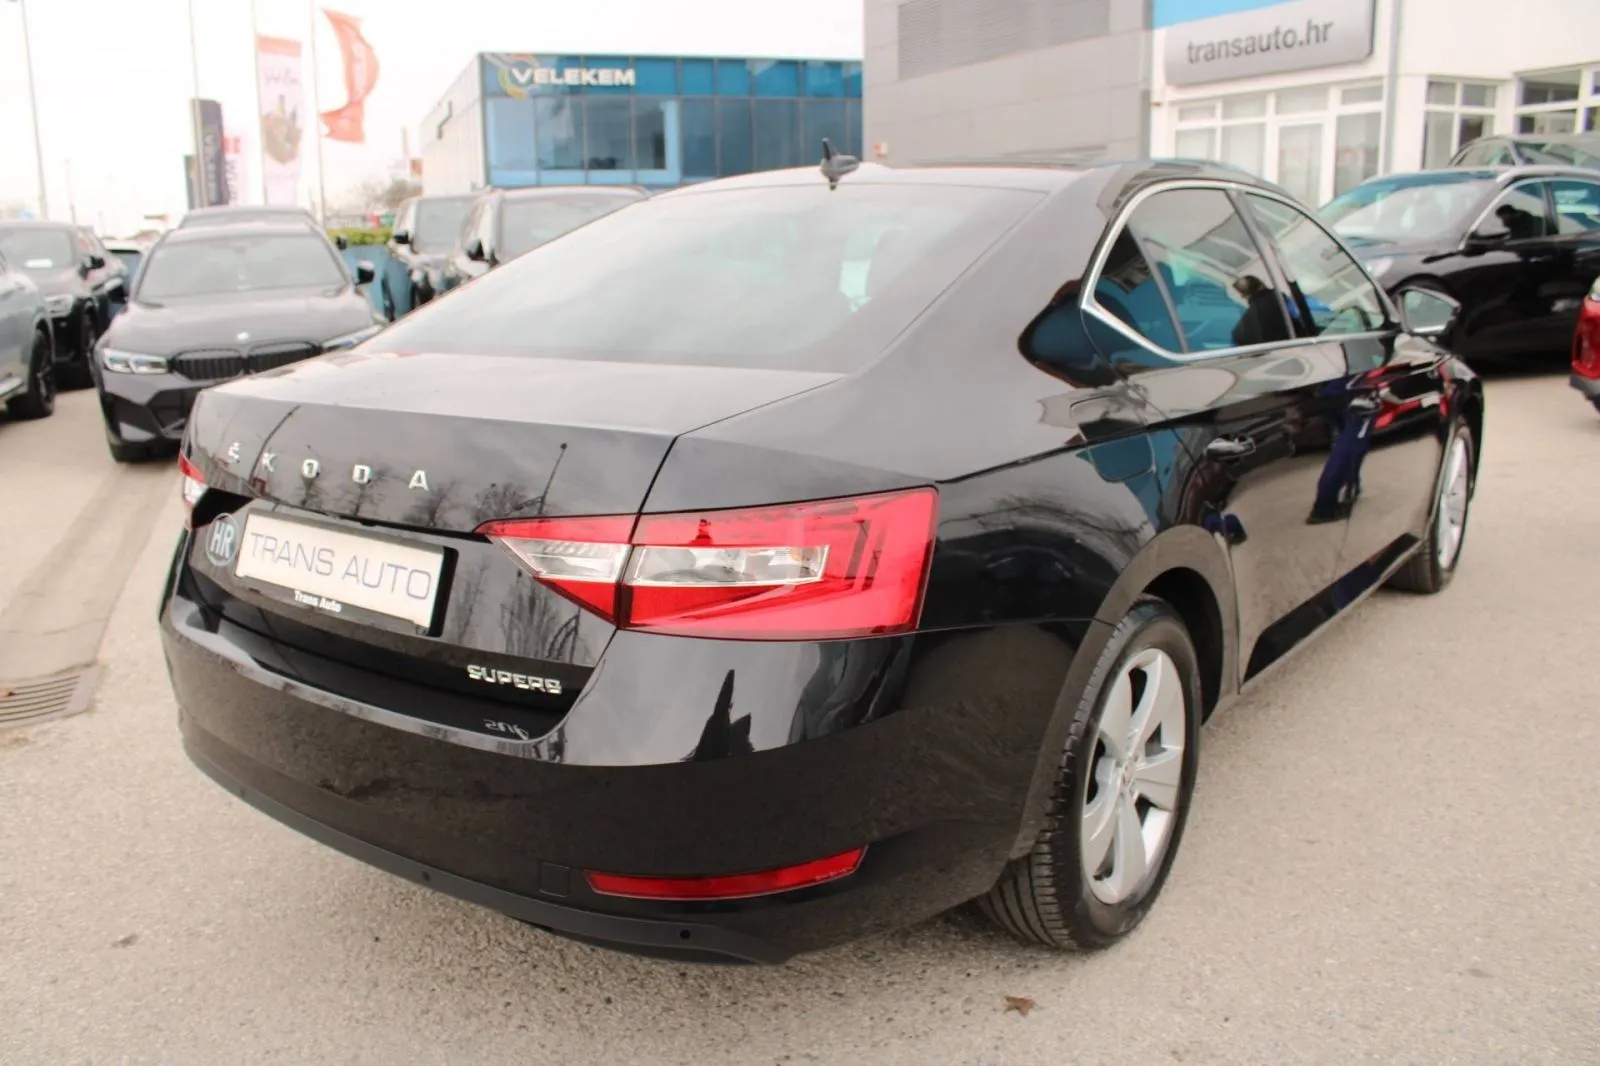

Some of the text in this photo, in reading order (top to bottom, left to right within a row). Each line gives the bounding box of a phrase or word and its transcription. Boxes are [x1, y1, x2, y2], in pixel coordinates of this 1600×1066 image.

[1186, 18, 1334, 65] transauto.hr
[511, 67, 637, 87] VELEKEM
[212, 524, 236, 559] HR
[249, 531, 433, 602] TRANS AUTO
[294, 589, 319, 607] Trans
[467, 664, 563, 694] SUPERB
